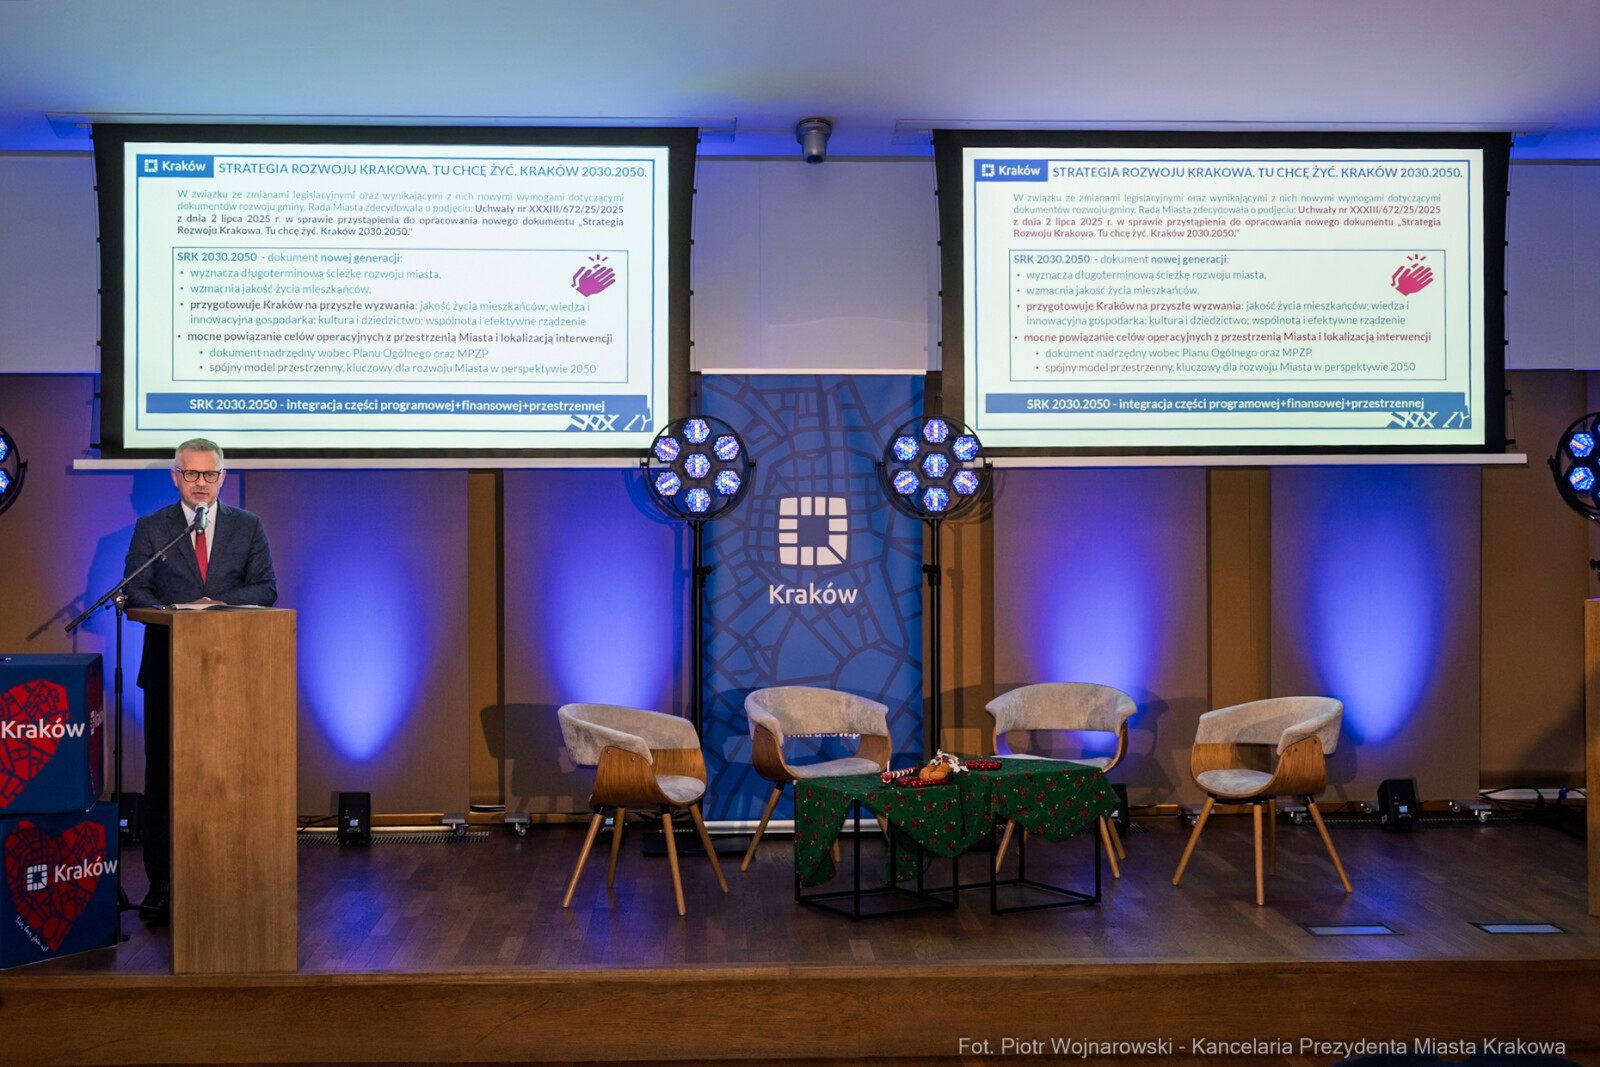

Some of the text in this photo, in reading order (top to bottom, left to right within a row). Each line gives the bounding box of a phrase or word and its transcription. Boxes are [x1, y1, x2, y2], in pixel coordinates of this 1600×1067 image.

[162, 160, 206, 172] Kraków
[219, 163, 647, 178] STRATEGIA ROZWOJU KRAKOWA. TU CHCĘ ŻYĆ. KRAKÓW 2030.2050.
[999, 165, 1041, 176] Kraków
[1053, 165, 1463, 180] STRATEGIA ROZWOJU KRAKOWA. TU CHCĘ ŻYĆ. KRAKÓW 2030.2050.
[186, 213, 207, 223] dnia
[211, 214, 217, 223] 2
[221, 214, 243, 225] lipca
[247, 214, 271, 224] 2025
[297, 215, 334, 225] sprawie
[338, 215, 400, 226] przystąpienia
[403, 216, 416, 225] do
[419, 216, 478, 226] opracowania
[482, 218, 519, 227] nowego
[522, 217, 575, 226] dokumentu
[1022, 217, 1042, 226] dnia
[1046, 217, 1051, 226] 2
[1055, 217, 1076, 228] lipca
[1080, 217, 1103, 227] 2025
[1128, 217, 1163, 228] sprawie
[1167, 217, 1226, 228] przystąpienia
[1230, 217, 1242, 226] do
[1245, 217, 1302, 228] opracowania
[1305, 219, 1340, 228] nowego
[1343, 217, 1394, 226] dokumentu
[177, 225, 218, 236] Rozwoju
[220, 226, 263, 235] Krakowa.
[265, 226, 276, 235] Tu
[278, 226, 300, 237] chcę
[301, 226, 319, 237] żyć.
[321, 225, 357, 236] Kraków
[1013, 229, 1052, 239] Rozwoju
[1054, 229, 1096, 238] Krakowa.
[1097, 229, 1108, 238] Tu
[1110, 229, 1131, 239] chcę
[1132, 229, 1149, 239] żyć.
[1151, 227, 1185, 239] Kraków
[178, 252, 199, 262] SRK
[201, 252, 258, 262] 2030.2050
[268, 253, 318, 262] dokument
[321, 253, 352, 264] nowej
[353, 253, 402, 265] generacji:
[1014, 254, 1034, 264] SRK
[1037, 254, 1090, 265] 2030.2050
[1100, 254, 1149, 264] dokument
[1151, 254, 1181, 266] nowej
[1182, 254, 1229, 266] generacji:
[189, 268, 441, 280] wyznacza długoterminową ścieżkę rozwoju miasta,
[1026, 285, 1200, 297] wzmacnia jakość życia mieszkańców,
[190, 300, 590, 313] przygotowuje Kraków na przyszłe wyzwania: jakość życia mieszkańców; wiedza i
[1026, 301, 1409, 313] przygotowuje Kraków na przyszłe wyzwania: jakość życia mieszkańców; wiedza i
[187, 331, 613, 345] mocne powiązanie celów operacyjnych z przestrzenią Miasta i lokalizacją interwencji
[1059, 332, 1115, 344] powiązanie
[1116, 332, 1146, 342] celów
[1147, 332, 1212, 344] operacyjnych
[1214, 334, 1219, 342] z
[1221, 331, 1282, 343] przestrzenią
[1284, 332, 1317, 341] Miasta
[1318, 332, 1322, 341] i
[1324, 332, 1374, 343] lokalizacją
[1376, 332, 1431, 343] interwencji
[190, 399, 214, 410] SRK
[216, 399, 278, 410] 2030.2050
[287, 399, 343, 414] integracja
[345, 399, 378, 414] części
[380, 400, 605, 414] programowej+finansowej+przestrzennej
[1027, 399, 1050, 410] SRK
[1052, 398, 1111, 410] 2030.2050
[1119, 398, 1173, 413] integracja
[1175, 398, 1207, 413] części
[1209, 398, 1424, 413] programowej+finansowej+przestrzennej
[769, 582, 858, 604] Kraków
[1, 718, 85, 739] Kraków
[54, 856, 118, 883] Kraków
